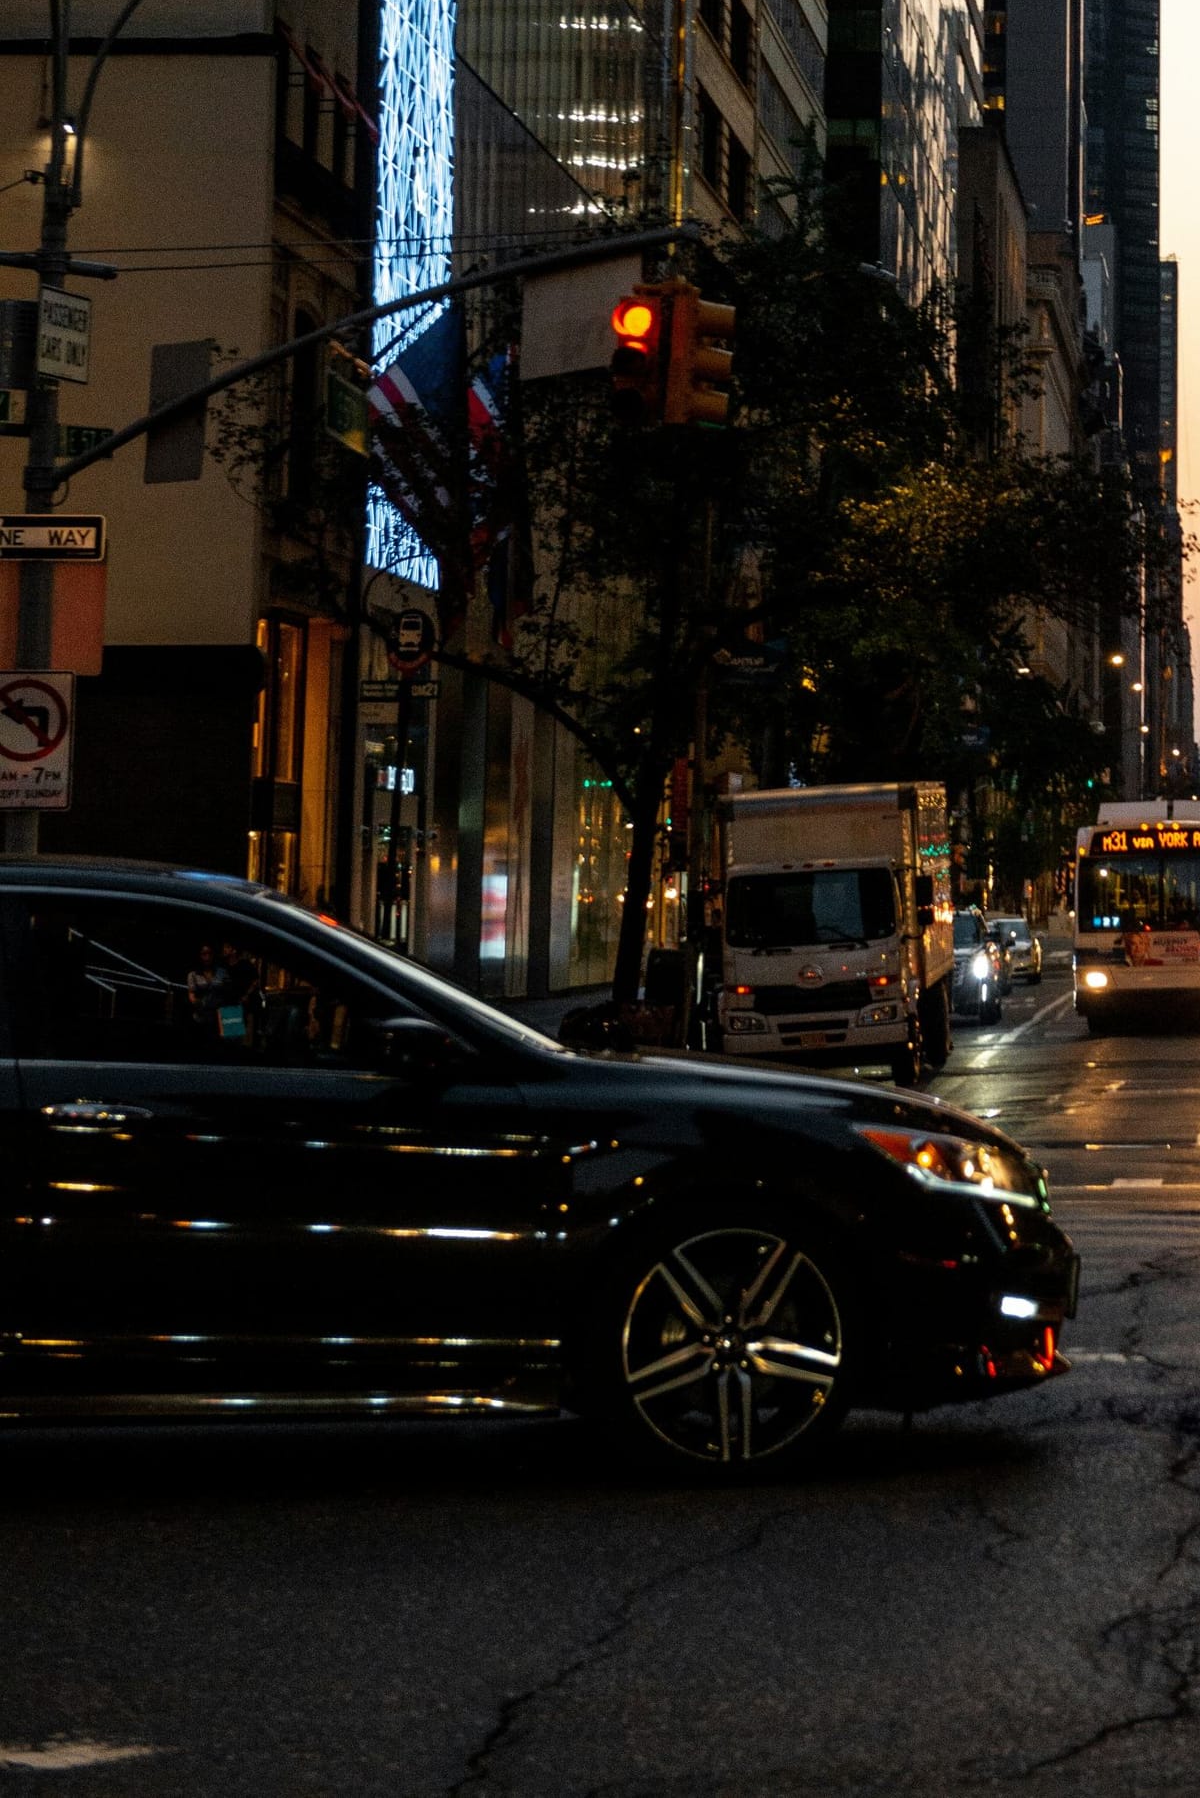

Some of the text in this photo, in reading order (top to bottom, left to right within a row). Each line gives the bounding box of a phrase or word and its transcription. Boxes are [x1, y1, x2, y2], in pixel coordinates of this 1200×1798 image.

[43, 300, 87, 332] PASSENGER
[66, 340, 86, 367] ONLY
[48, 530, 90, 546] WAY
[1102, 831, 1128, 852] M31
[1158, 831, 1189, 848] YORK
